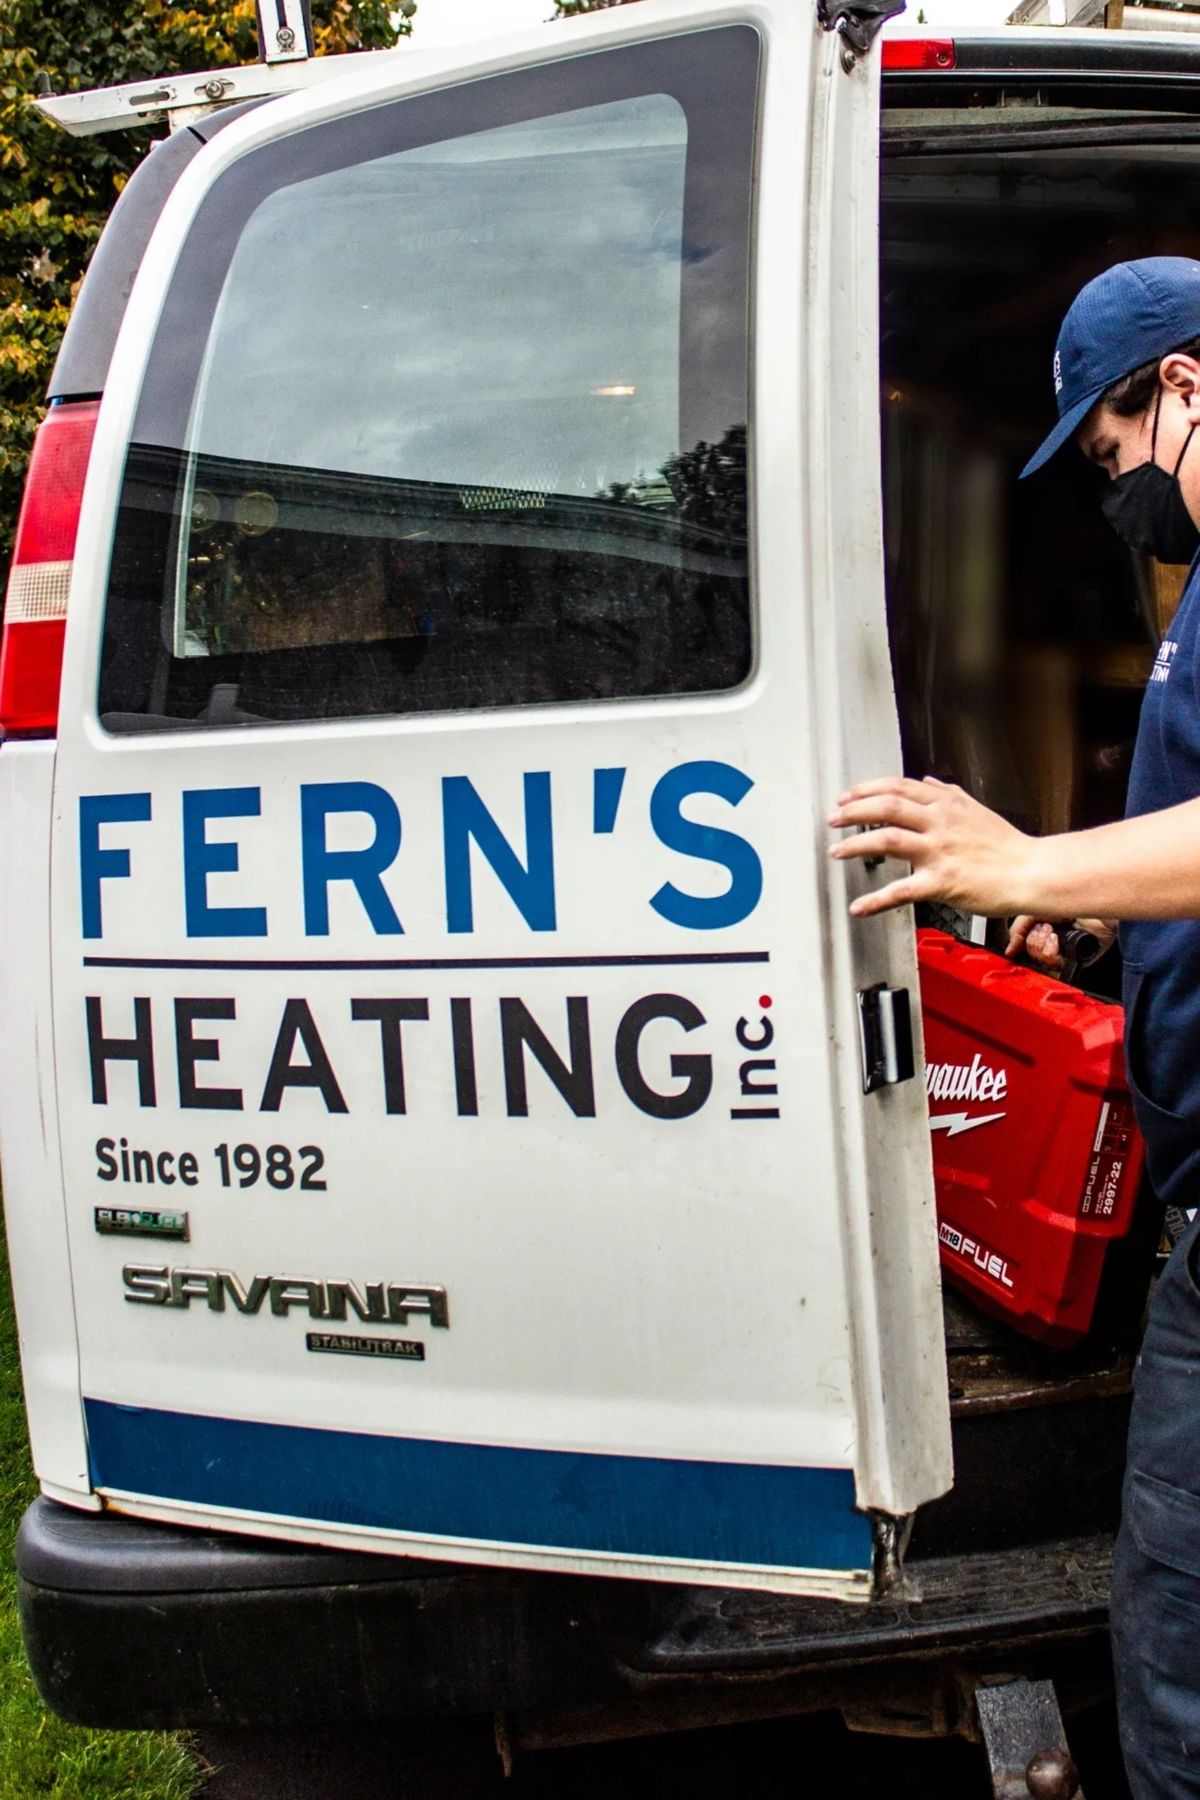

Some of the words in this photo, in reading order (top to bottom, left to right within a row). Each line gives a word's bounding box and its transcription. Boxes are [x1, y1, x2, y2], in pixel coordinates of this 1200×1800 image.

[79, 760, 764, 940] FERN'S
[85, 993, 714, 1121] HEATING
[730, 994, 780, 1120] Inc.
[95, 1137, 200, 1186] Since
[213, 1143, 328, 1191] 1982
[1103, 1161, 1122, 1215] 2997-22
[122, 1262, 449, 1329] SAVANA
[960, 1238, 1014, 1288] FUEL
